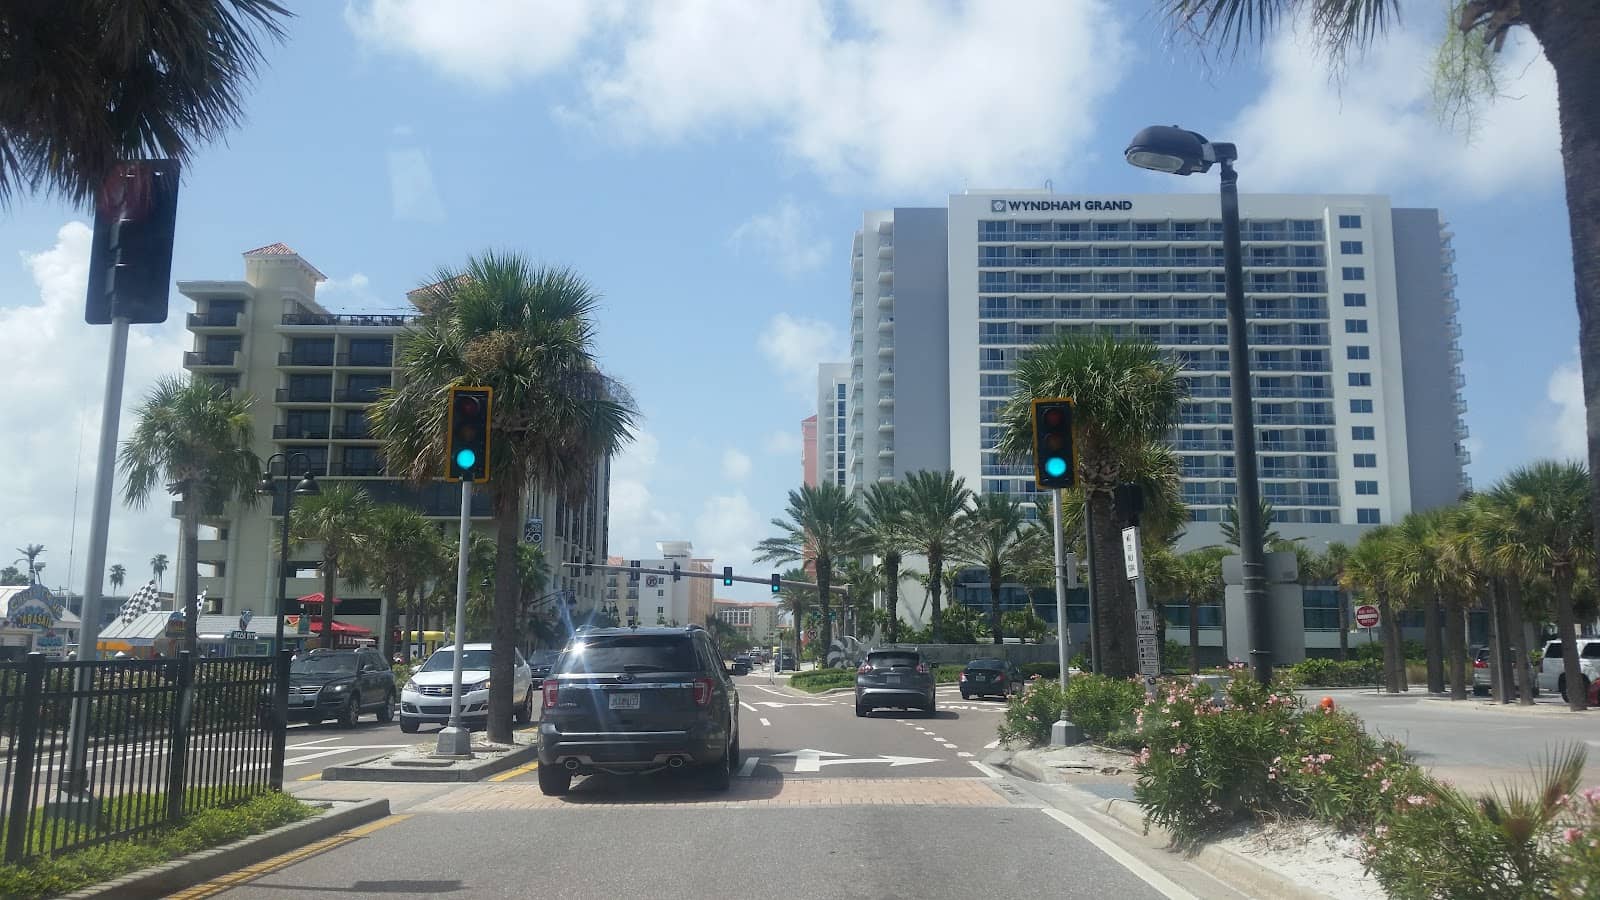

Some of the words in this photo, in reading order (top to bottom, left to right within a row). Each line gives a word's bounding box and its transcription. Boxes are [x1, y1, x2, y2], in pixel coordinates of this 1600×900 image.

[1009, 200, 1081, 211] WYNDHAM
[1085, 200, 1133, 211] GRAND
[525, 532, 542, 543] 60
